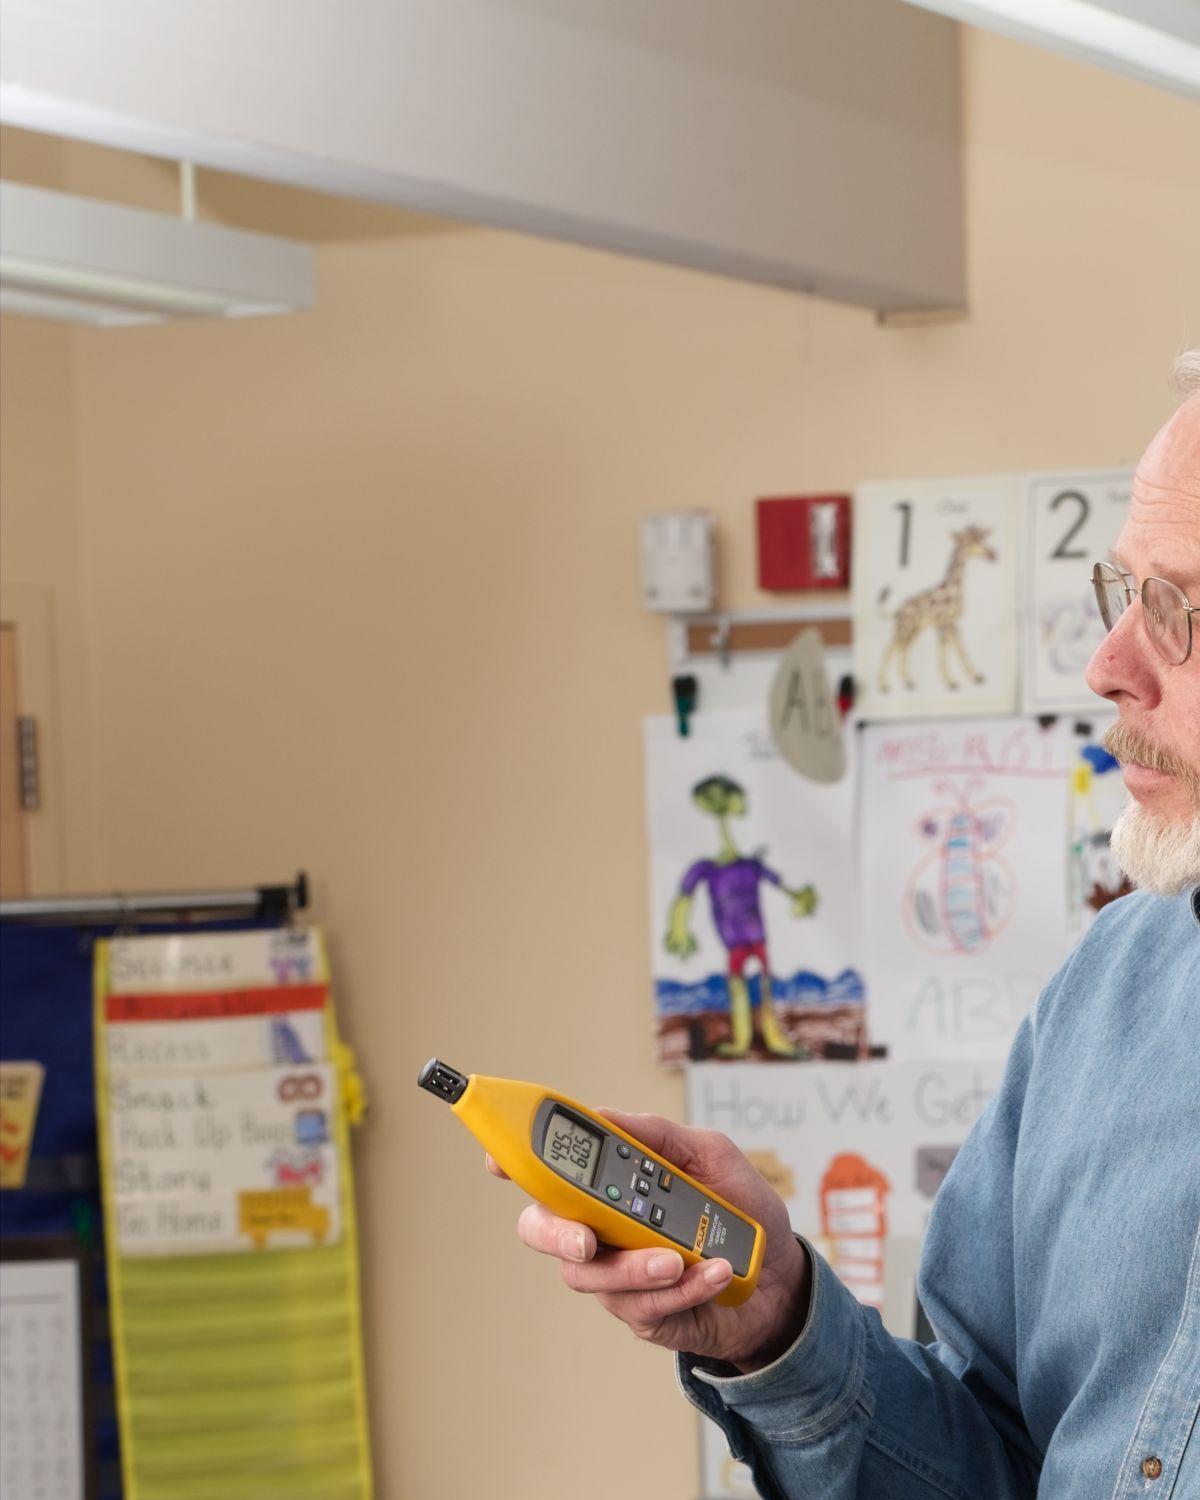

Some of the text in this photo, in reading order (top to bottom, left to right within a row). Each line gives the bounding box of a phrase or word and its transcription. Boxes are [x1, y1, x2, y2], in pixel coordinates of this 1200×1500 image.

[895, 502, 912, 568] 1
[1048, 490, 1091, 560] 2
[702, 1077, 808, 1131] How
[813, 1077, 895, 1126] We
[550, 1131, 572, 1161] 49.5
[569, 1135, 593, 1170] 60.5
[697, 1217, 708, 1249] FLUKE
